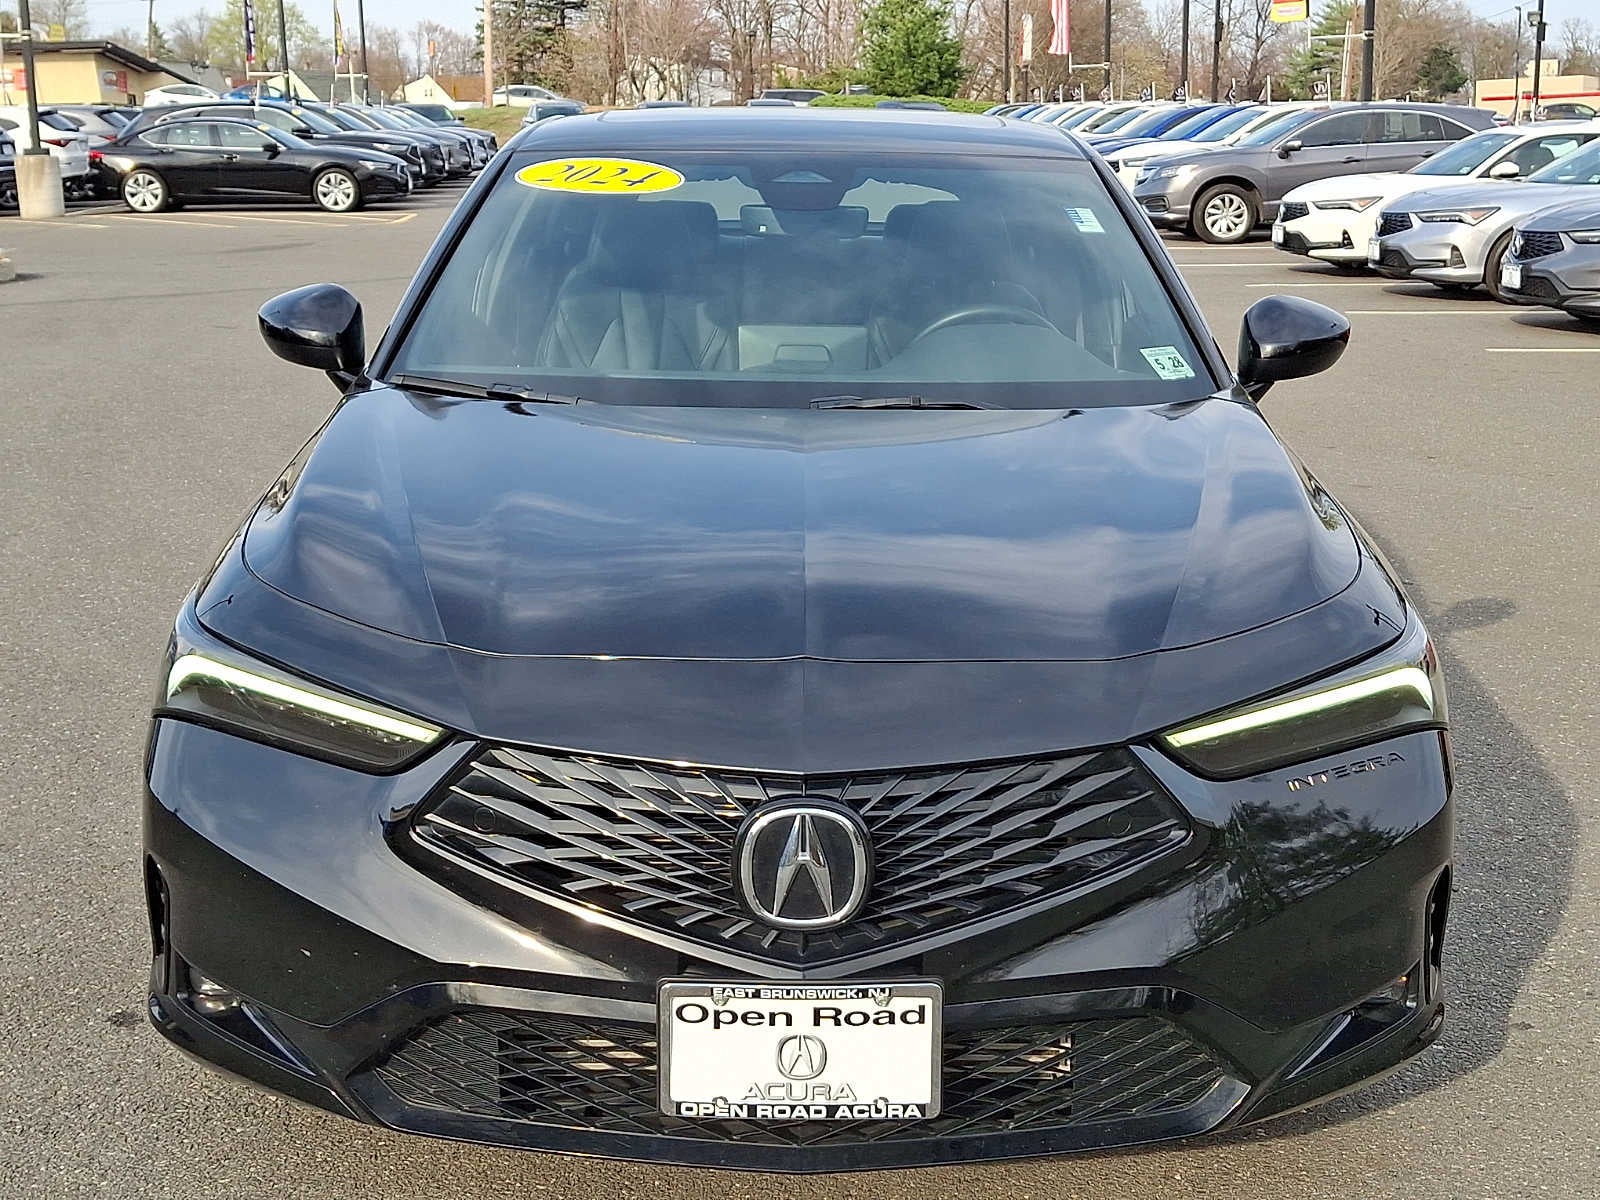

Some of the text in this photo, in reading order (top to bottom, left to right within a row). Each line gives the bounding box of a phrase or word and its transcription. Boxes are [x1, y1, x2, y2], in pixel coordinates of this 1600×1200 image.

[535, 164, 664, 187] 2024
[1168, 356, 1184, 368] 28
[1286, 752, 1406, 792] INTEGRA
[712, 987, 755, 999] EAST
[867, 987, 891, 999] NJ
[675, 1003, 926, 1030] Open Road
[742, 1081, 858, 1102] ACURA
[680, 1102, 922, 1119] OPEN ROAD ACURA
